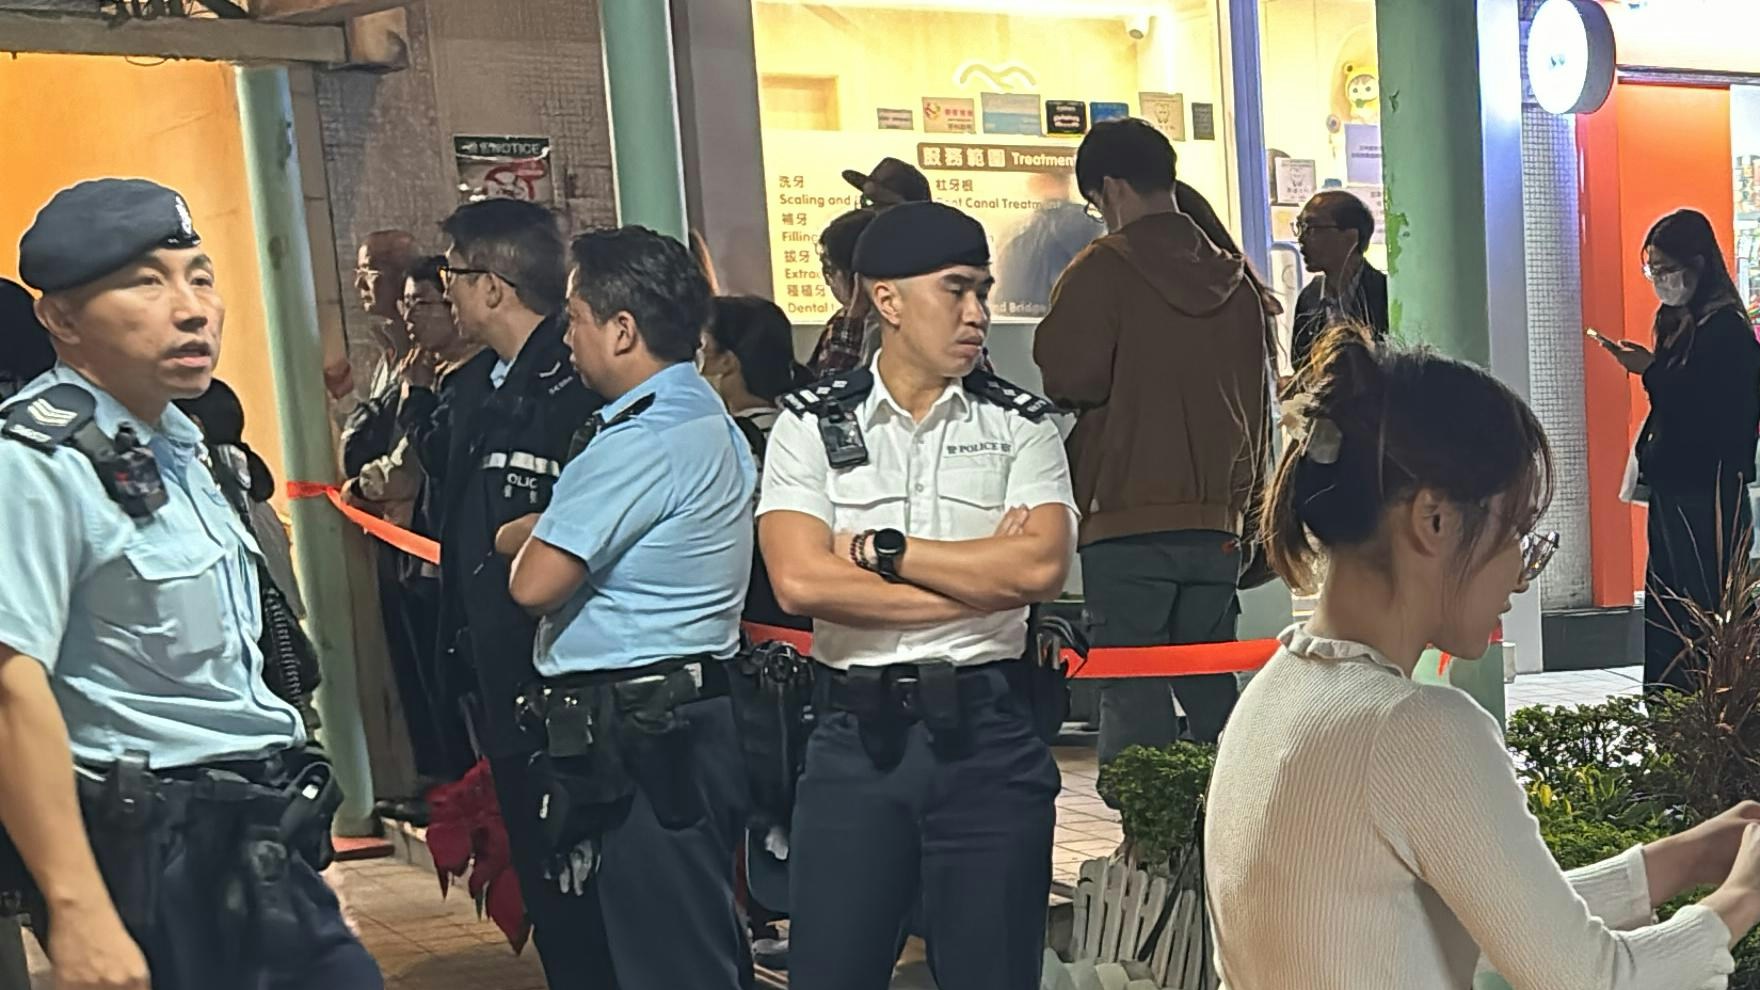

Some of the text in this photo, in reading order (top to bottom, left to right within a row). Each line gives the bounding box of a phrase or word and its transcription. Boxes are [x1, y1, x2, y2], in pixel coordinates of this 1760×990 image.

[922, 146, 1006, 168] 服務範圍
[779, 176, 804, 189] 洗牙
[780, 194, 826, 208] Scaling
[828, 194, 851, 205] and
[788, 303, 828, 314] Dental
[959, 441, 999, 453] POLICE
[507, 472, 538, 490] OLIC
